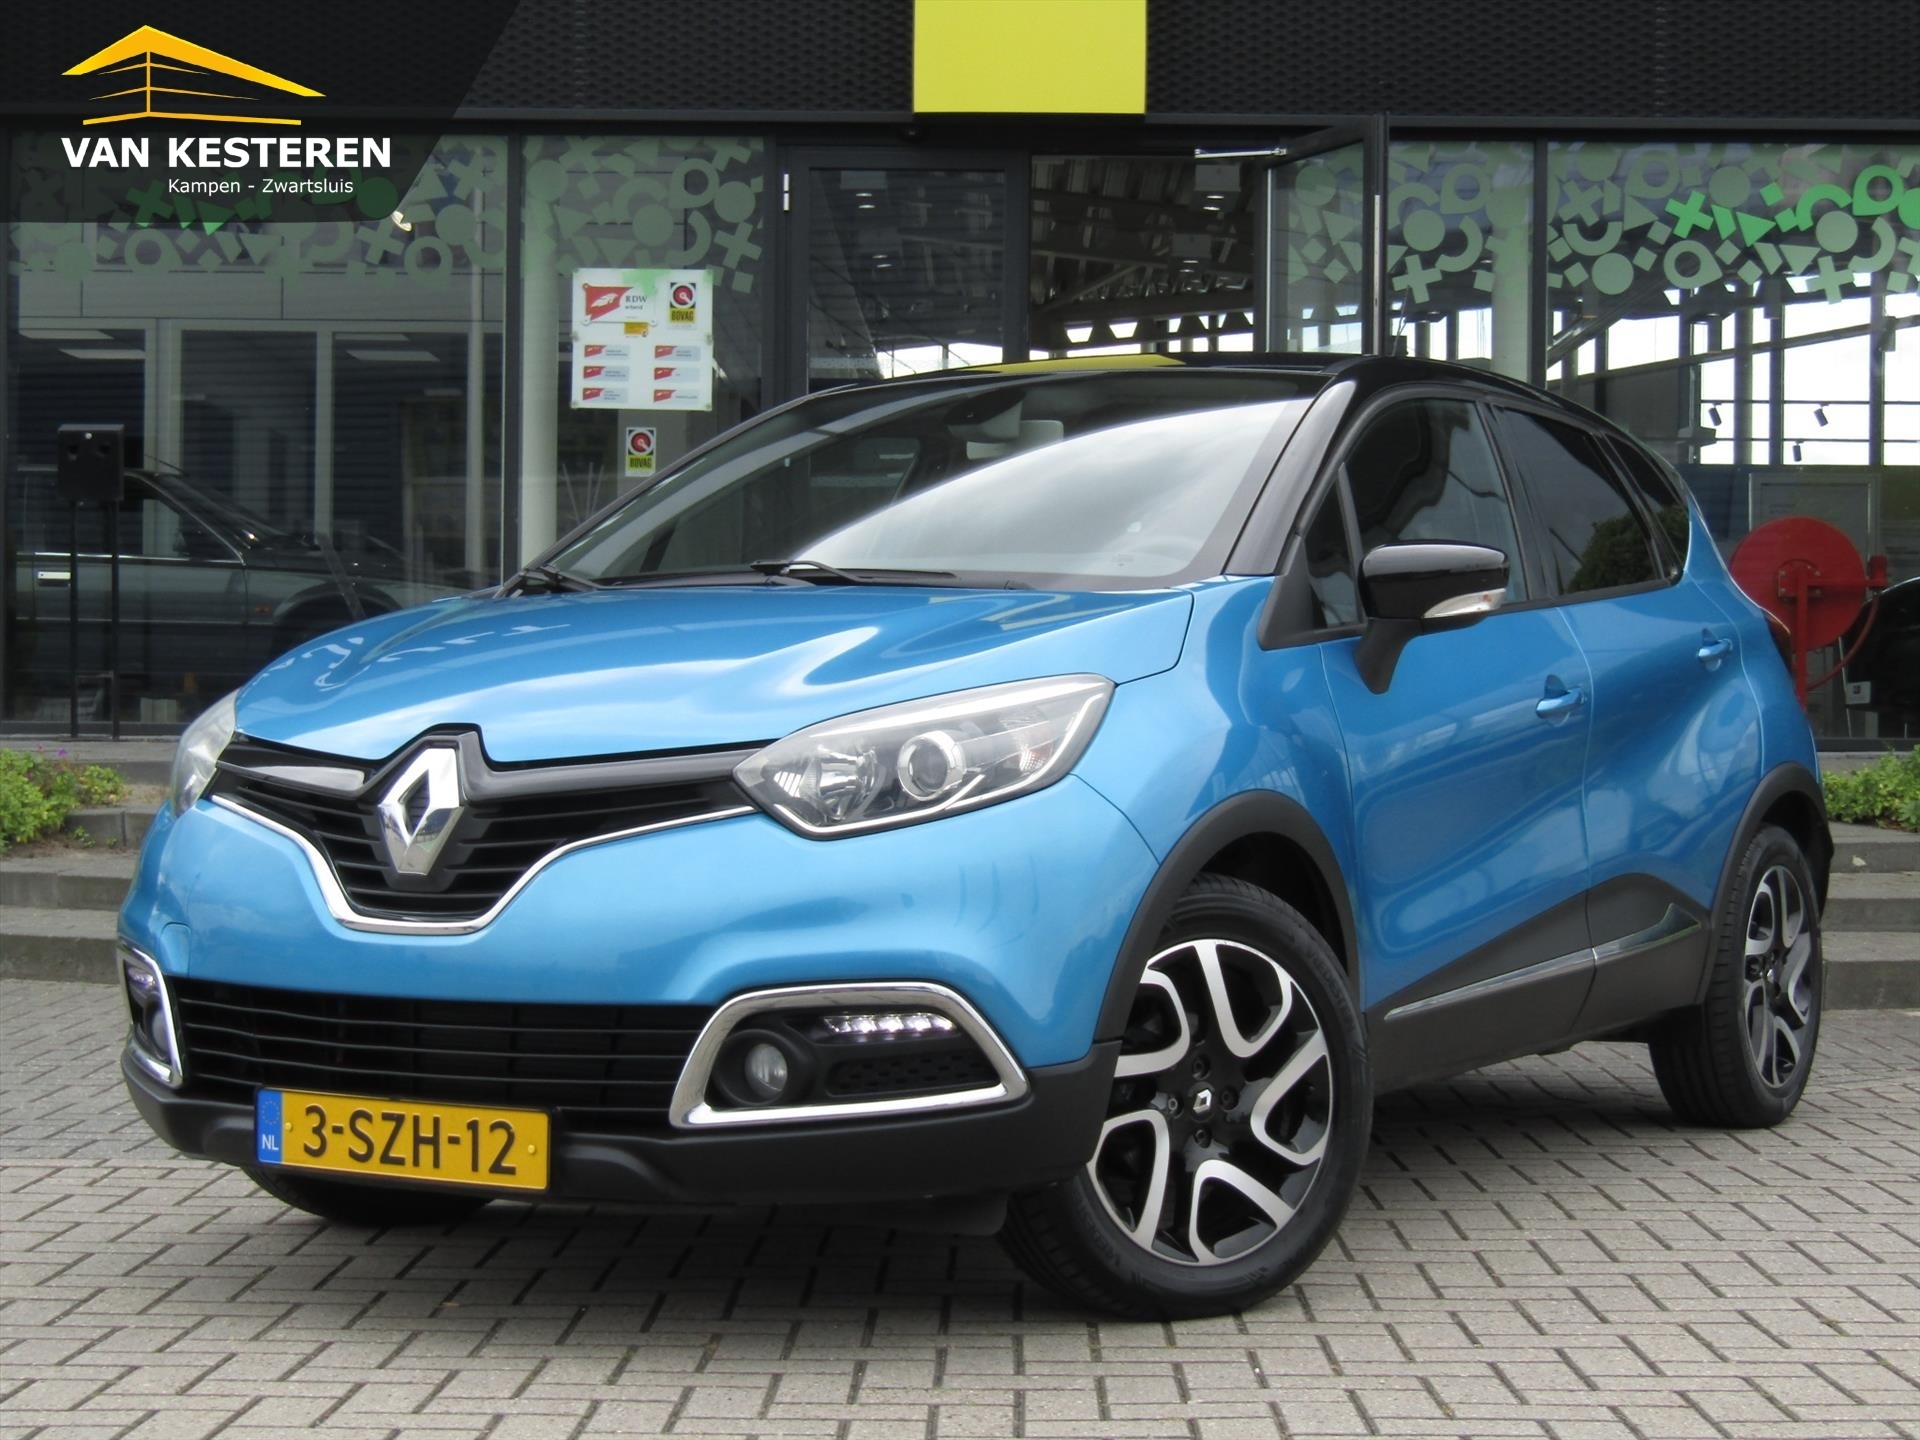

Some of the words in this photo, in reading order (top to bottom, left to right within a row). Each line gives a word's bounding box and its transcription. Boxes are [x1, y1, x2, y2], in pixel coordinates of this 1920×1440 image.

[625, 295, 648, 303] RDW
[671, 310, 694, 321] BOVAG
[629, 457, 652, 469] BOVAG
[261, 1133, 279, 1151] NL
[303, 1103, 517, 1176] 3-SZH-12
